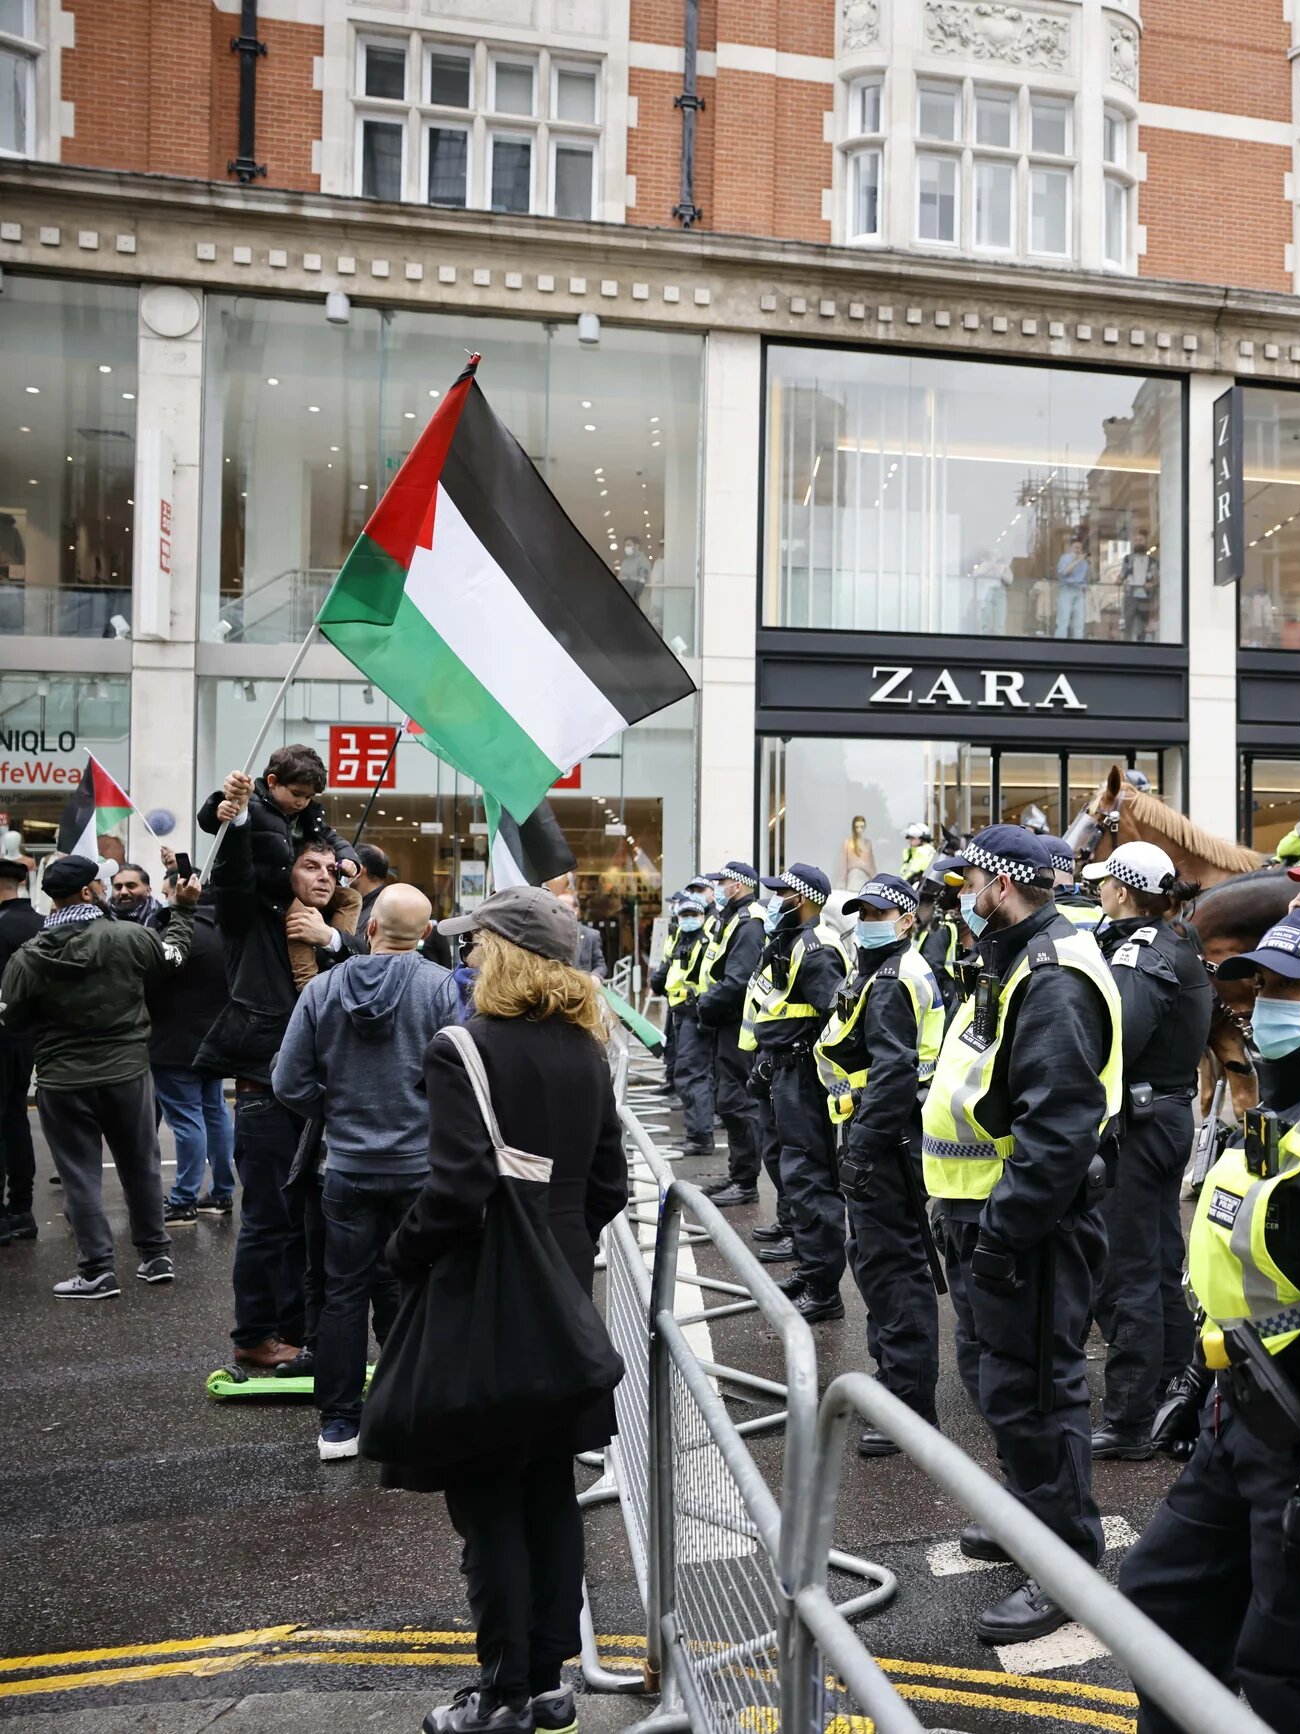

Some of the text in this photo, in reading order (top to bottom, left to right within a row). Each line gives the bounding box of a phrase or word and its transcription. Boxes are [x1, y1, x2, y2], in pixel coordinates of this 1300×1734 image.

[1216, 414, 1232, 562] ZARA
[869, 666, 1088, 709] ZARA
[0, 761, 83, 783] feWea
